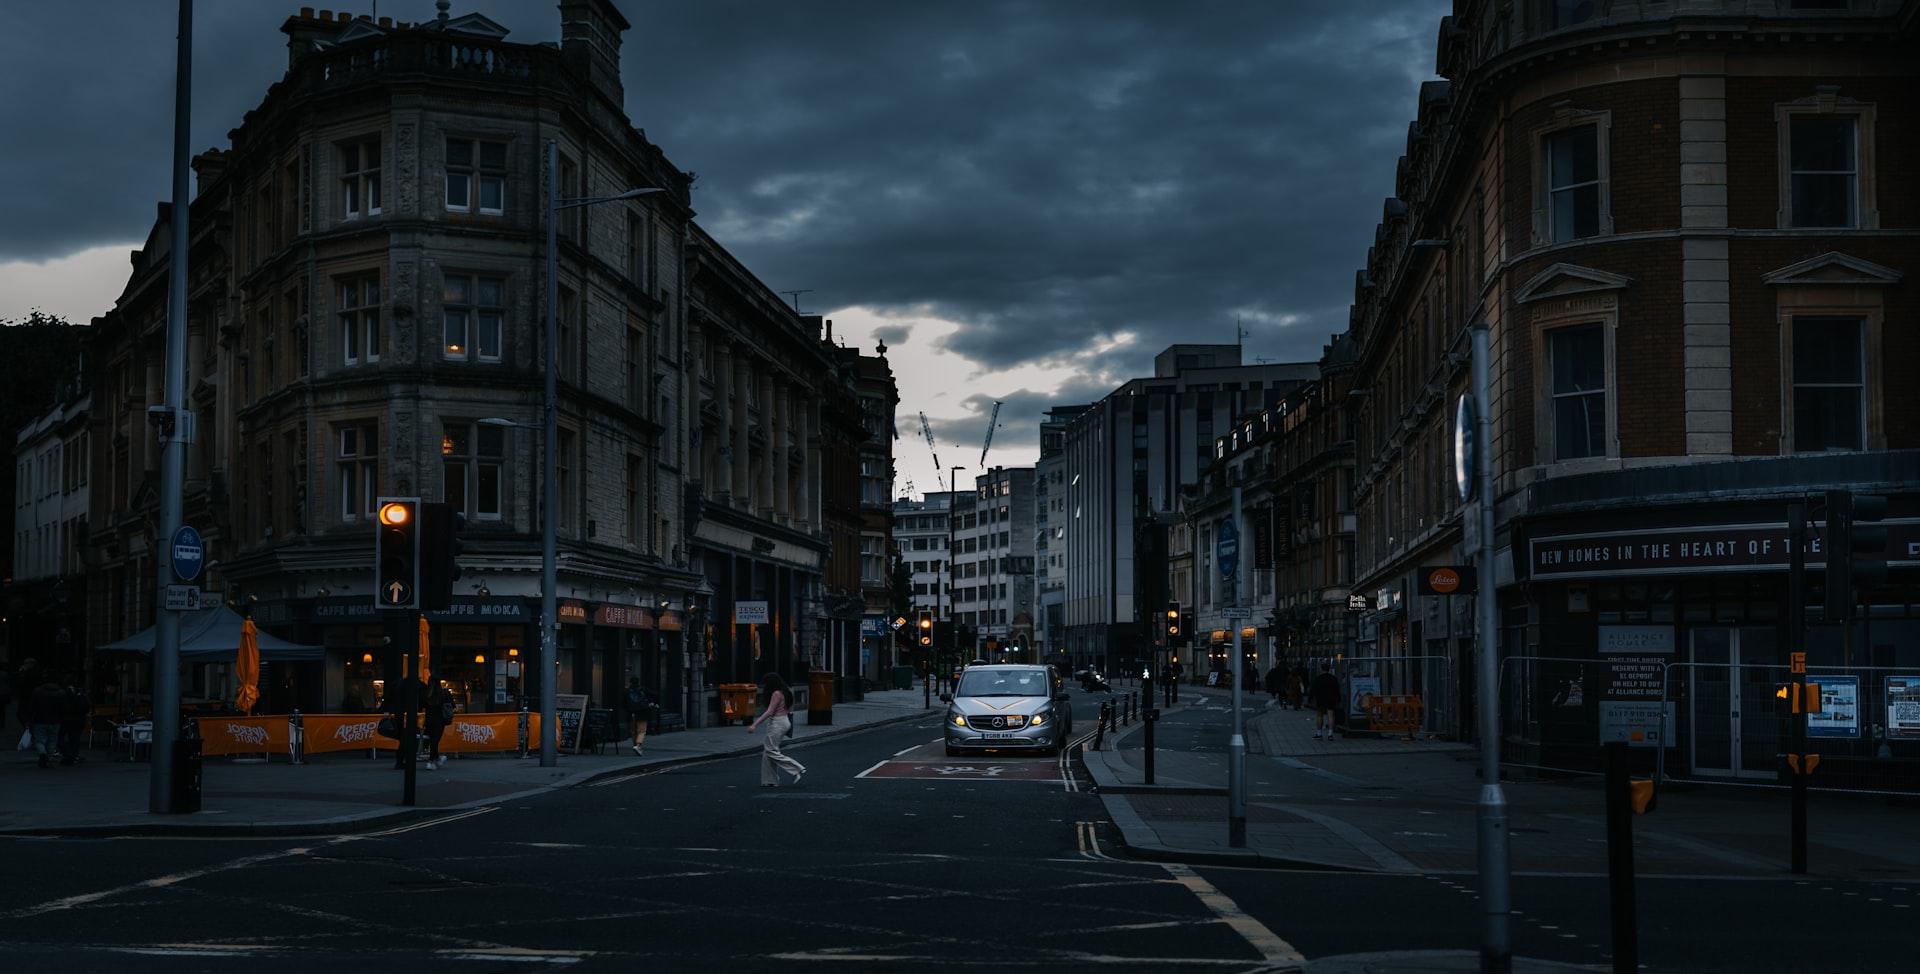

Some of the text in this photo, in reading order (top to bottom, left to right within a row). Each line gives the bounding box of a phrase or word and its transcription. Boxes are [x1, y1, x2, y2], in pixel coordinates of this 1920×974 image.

[1541, 537, 1820, 564] NEW HOMES IN THE HEART OF TE
[1431, 574, 1456, 585] Leica
[480, 604, 520, 615] MOKA
[739, 606, 765, 614] TESCO
